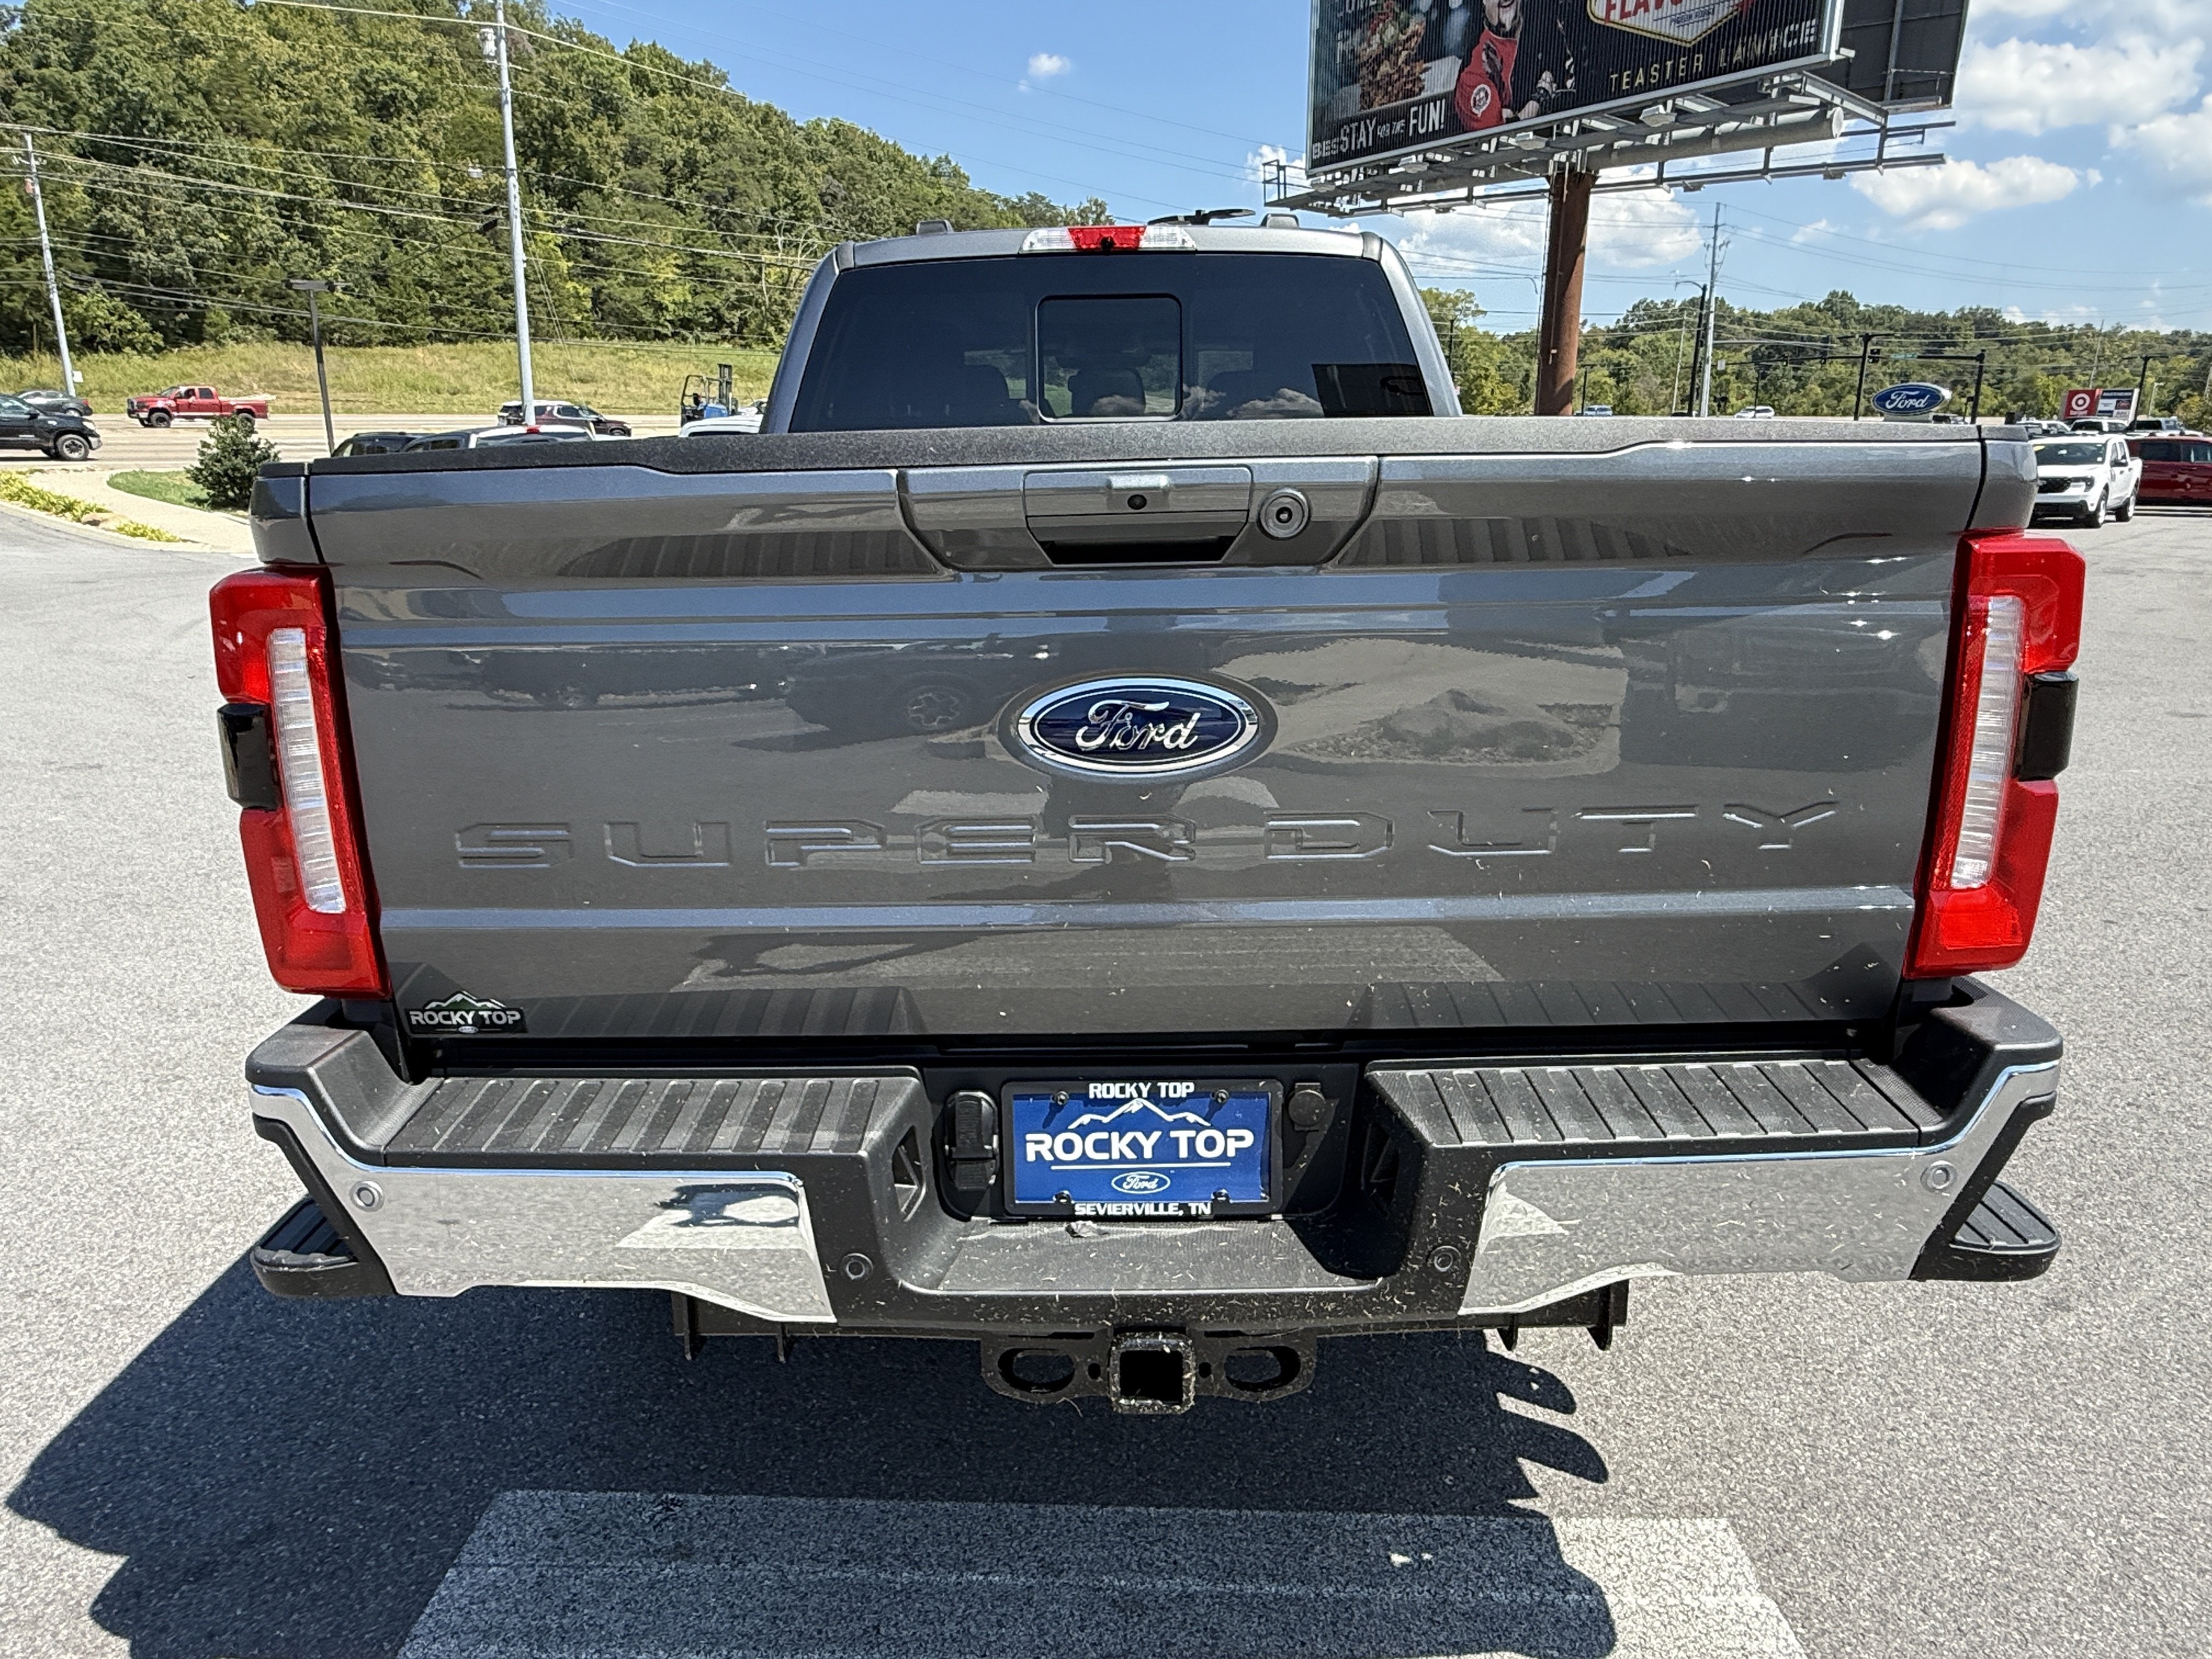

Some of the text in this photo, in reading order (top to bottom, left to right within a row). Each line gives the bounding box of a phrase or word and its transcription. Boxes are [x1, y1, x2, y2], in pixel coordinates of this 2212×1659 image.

[1610, 54, 1703, 92] TEASTER
[1340, 117, 1376, 153] STAY
[1409, 99, 1446, 137] FUN!
[1886, 391, 1931, 409] Ford
[1075, 700, 1201, 751] Ford
[453, 800, 1840, 869] SUPER DUTY
[409, 1011, 521, 1025] ROCKY TOP
[1088, 1082, 1194, 1098] ROCKY TOP
[1025, 1129, 1254, 1162] ROCKY TOP
[1122, 1174, 1158, 1190] Ford
[1074, 1202, 1212, 1216] SEVIERVILLE, TN
